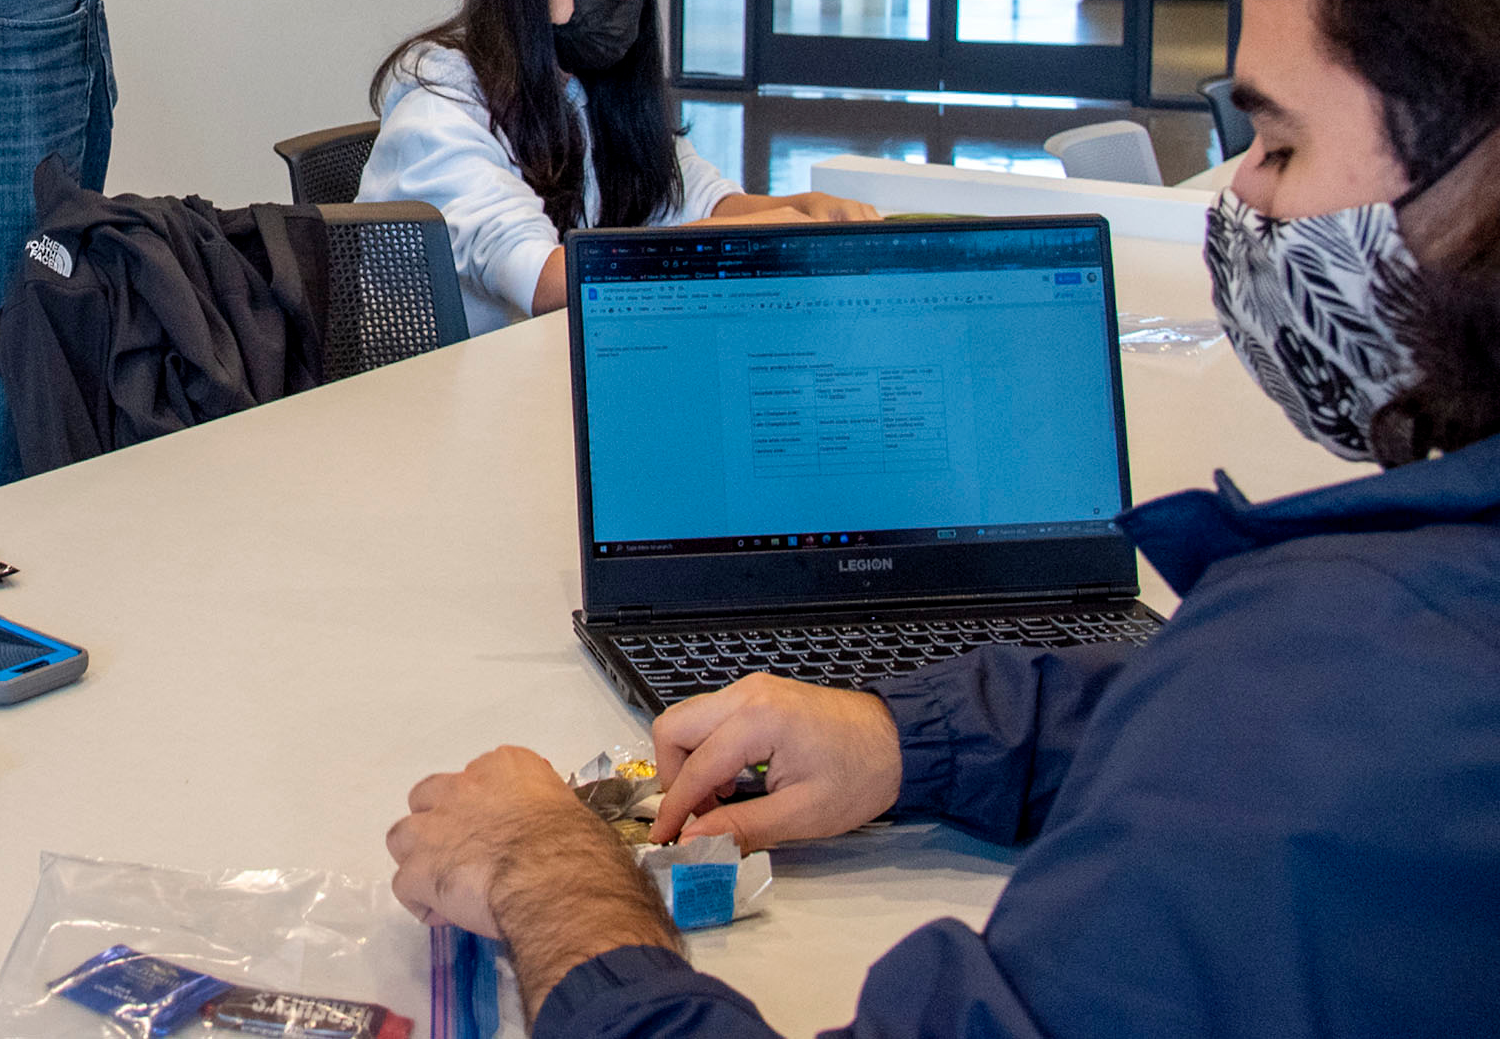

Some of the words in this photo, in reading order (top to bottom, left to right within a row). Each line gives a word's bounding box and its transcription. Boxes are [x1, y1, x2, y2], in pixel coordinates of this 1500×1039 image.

[42, 234, 60, 251] THE
[29, 249, 56, 269] FACE
[838, 557, 893, 572] LEGION
